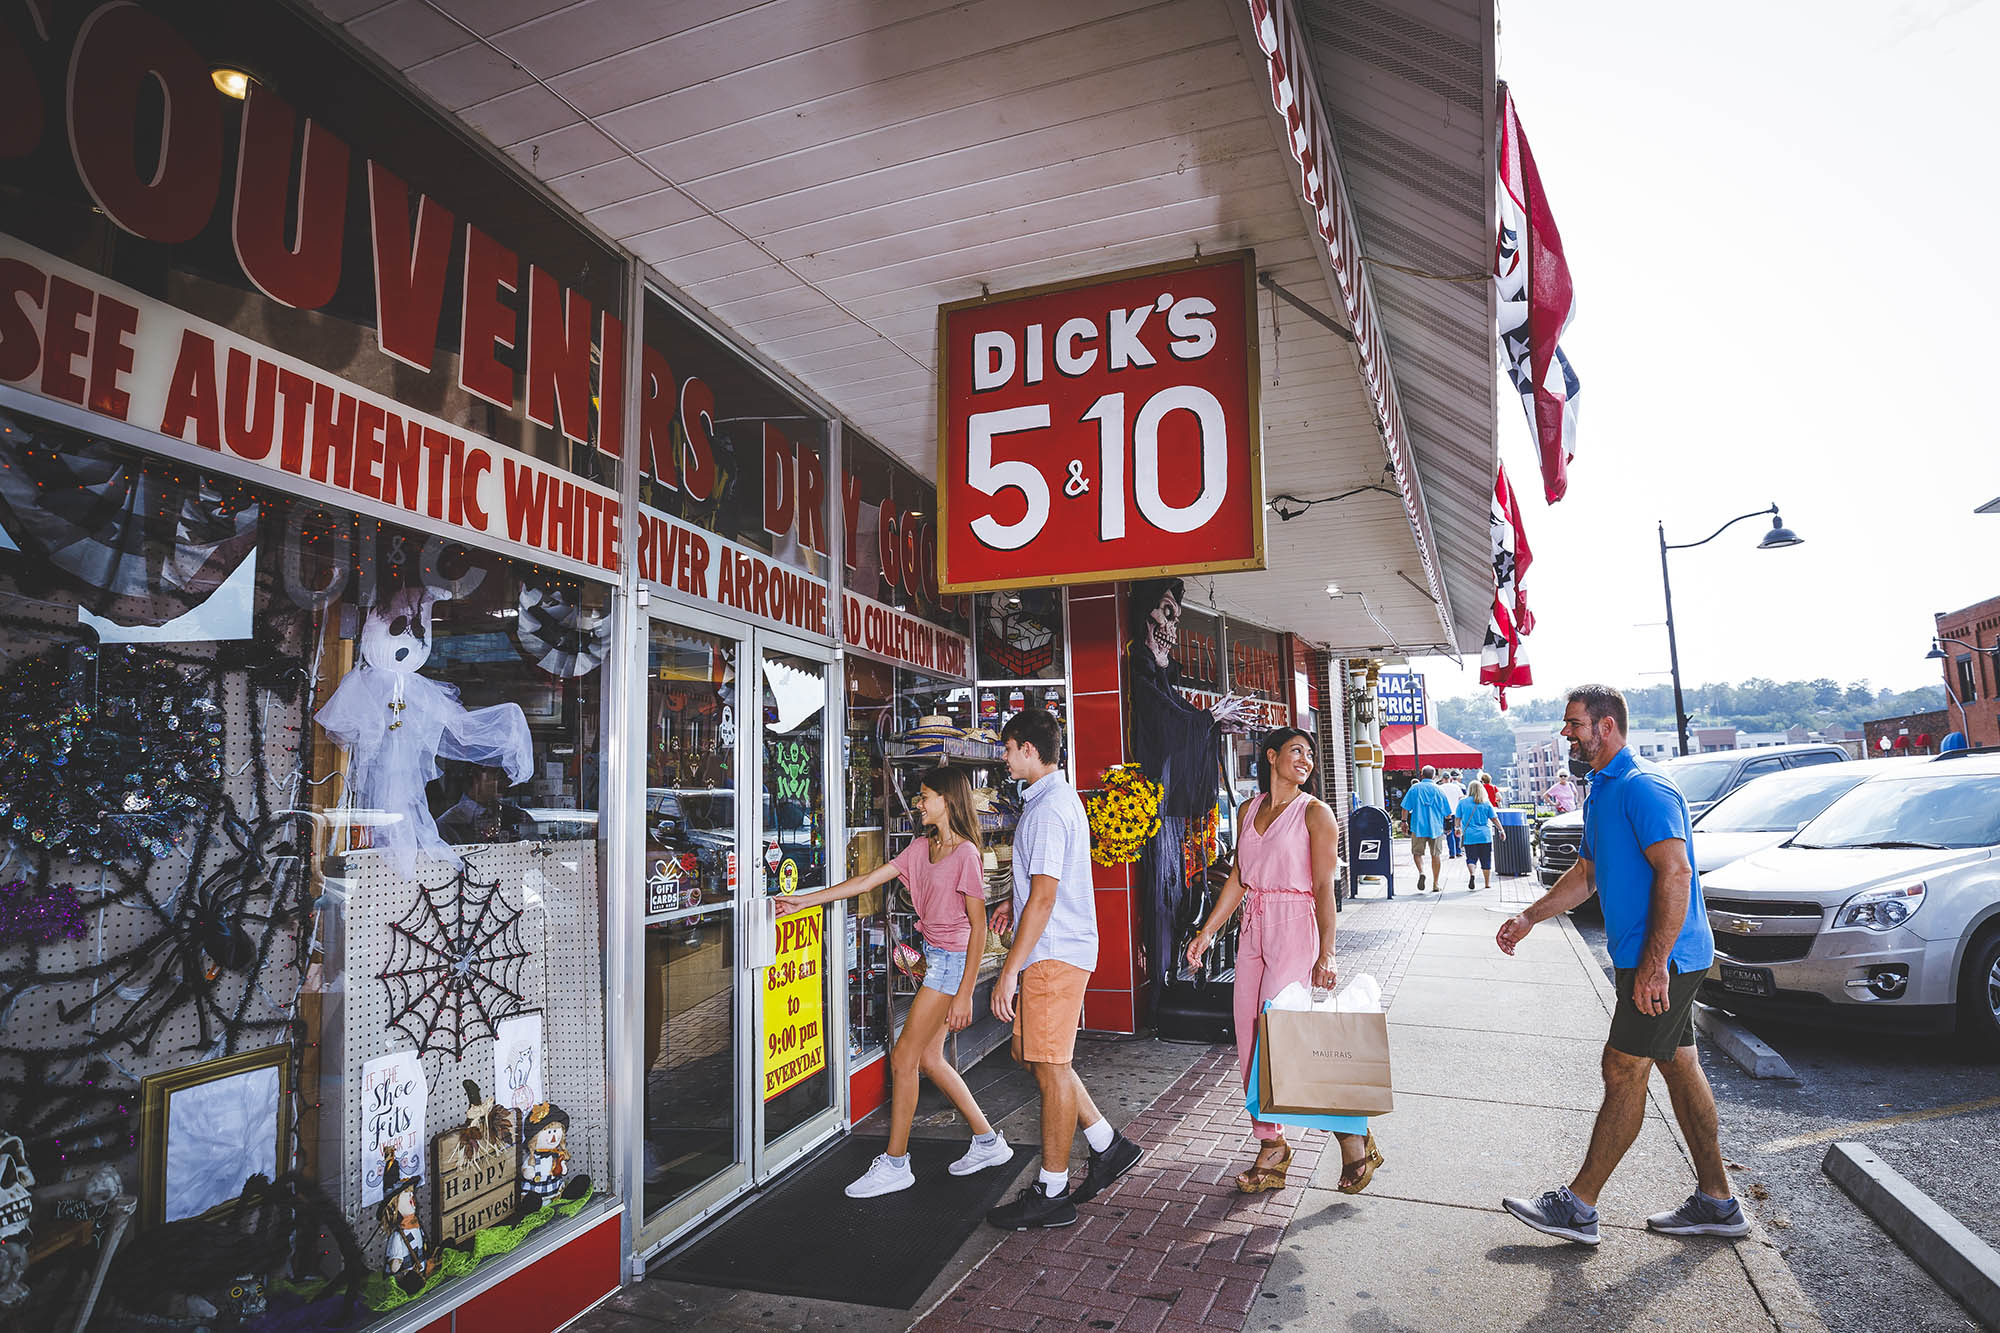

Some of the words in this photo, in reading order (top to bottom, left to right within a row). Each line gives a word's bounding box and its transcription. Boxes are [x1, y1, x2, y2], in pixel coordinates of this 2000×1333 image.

[972, 292, 1218, 392] DICK'S
[0, 257, 139, 423] SEE
[160, 327, 492, 532] AUTHENTIC
[502, 456, 622, 572] WHITE
[637, 512, 711, 599] RIVER
[864, 604, 934, 669] COLLECTION
[936, 630, 967, 678] INSIDE
[968, 403, 1051, 550] 5
[1063, 459, 1090, 498] &
[1080, 385, 1229, 542] 10
[1173, 628, 1217, 684] IFTS
[1378, 696, 1423, 714] PRICE
[652, 893, 677, 905] CARDS
[656, 883, 674, 895] GIFT
[768, 959, 796, 991] 8:30
[798, 959, 817, 980] am
[787, 994, 800, 1017] to
[768, 1024, 796, 1060] 9:00
[799, 1020, 818, 1050] pm
[365, 1072, 376, 1092] IF
[380, 1064, 399, 1086] THE
[766, 1046, 823, 1093] EVERYDAY
[369, 1077, 417, 1113] Shoe
[368, 1105, 413, 1152] Fits
[408, 1131, 417, 1149] IT
[444, 1159, 506, 1200] Happy
[453, 1189, 514, 1240] Harvest
